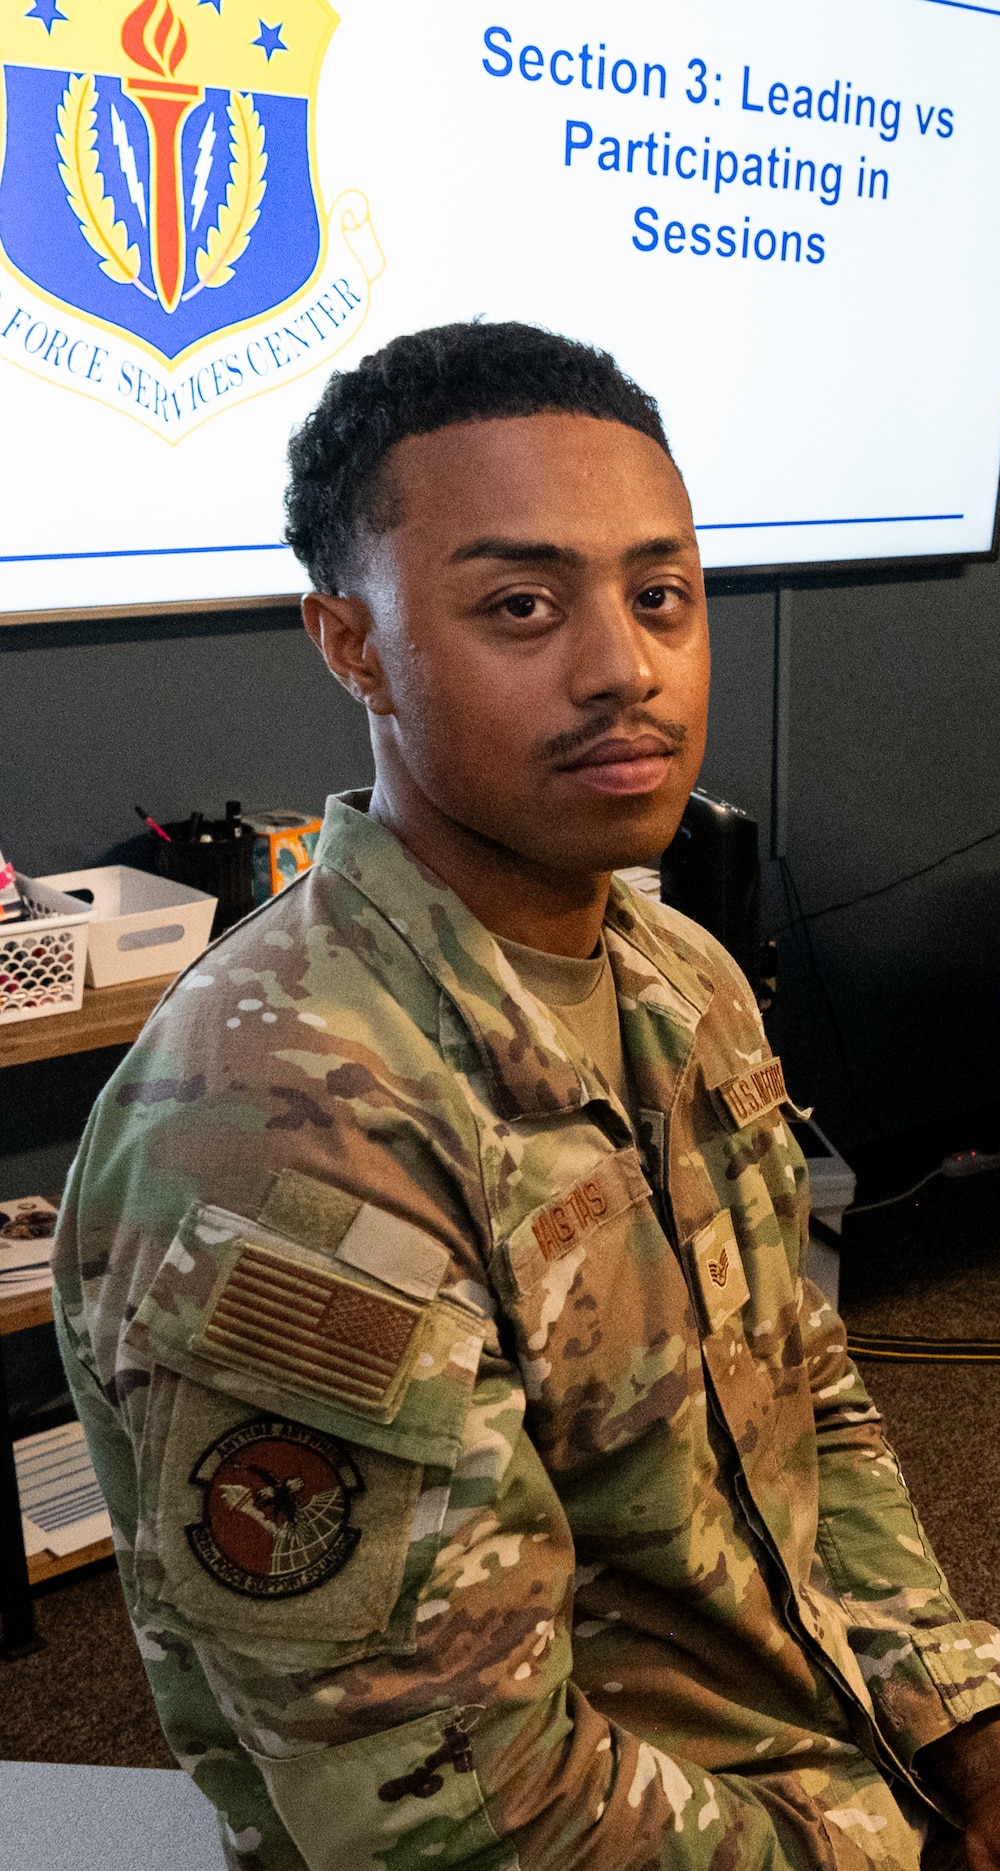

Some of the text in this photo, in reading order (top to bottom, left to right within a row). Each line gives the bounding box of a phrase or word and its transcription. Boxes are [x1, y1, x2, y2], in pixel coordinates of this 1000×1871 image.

[481, 26, 955, 142] Section 3: Leading vs
[564, 119, 890, 206] Participating in
[631, 206, 826, 264] Sessions
[1, 278, 361, 423] FORCE SERVICES CENTER
